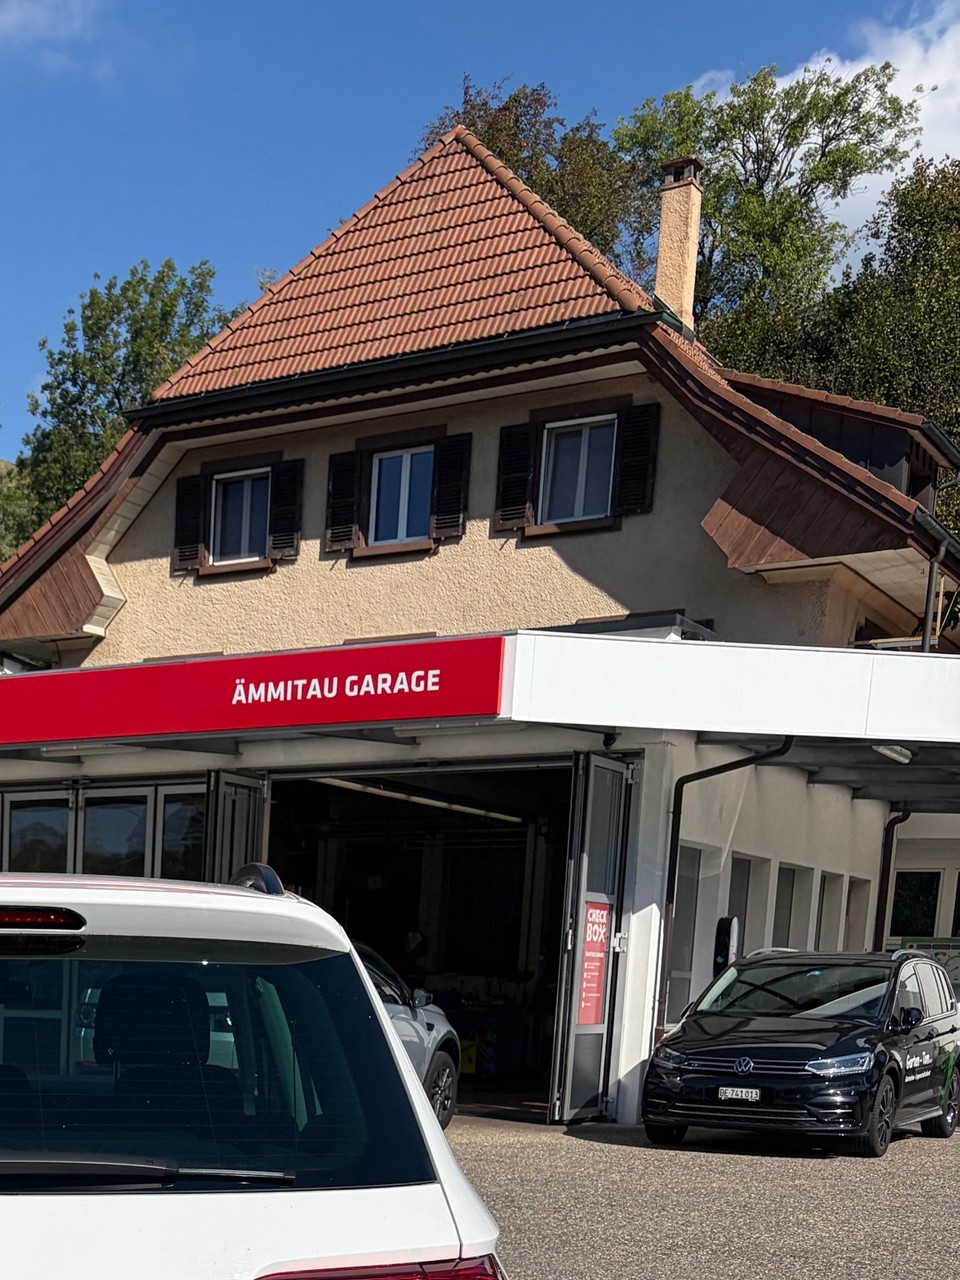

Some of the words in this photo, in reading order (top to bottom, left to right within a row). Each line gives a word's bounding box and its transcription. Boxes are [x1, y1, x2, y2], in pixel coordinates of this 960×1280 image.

[231, 678, 338, 705] ÄMMITAU
[344, 669, 440, 697] GARAGE
[587, 909, 608, 923] CHECK
[586, 922, 607, 943] BOX
